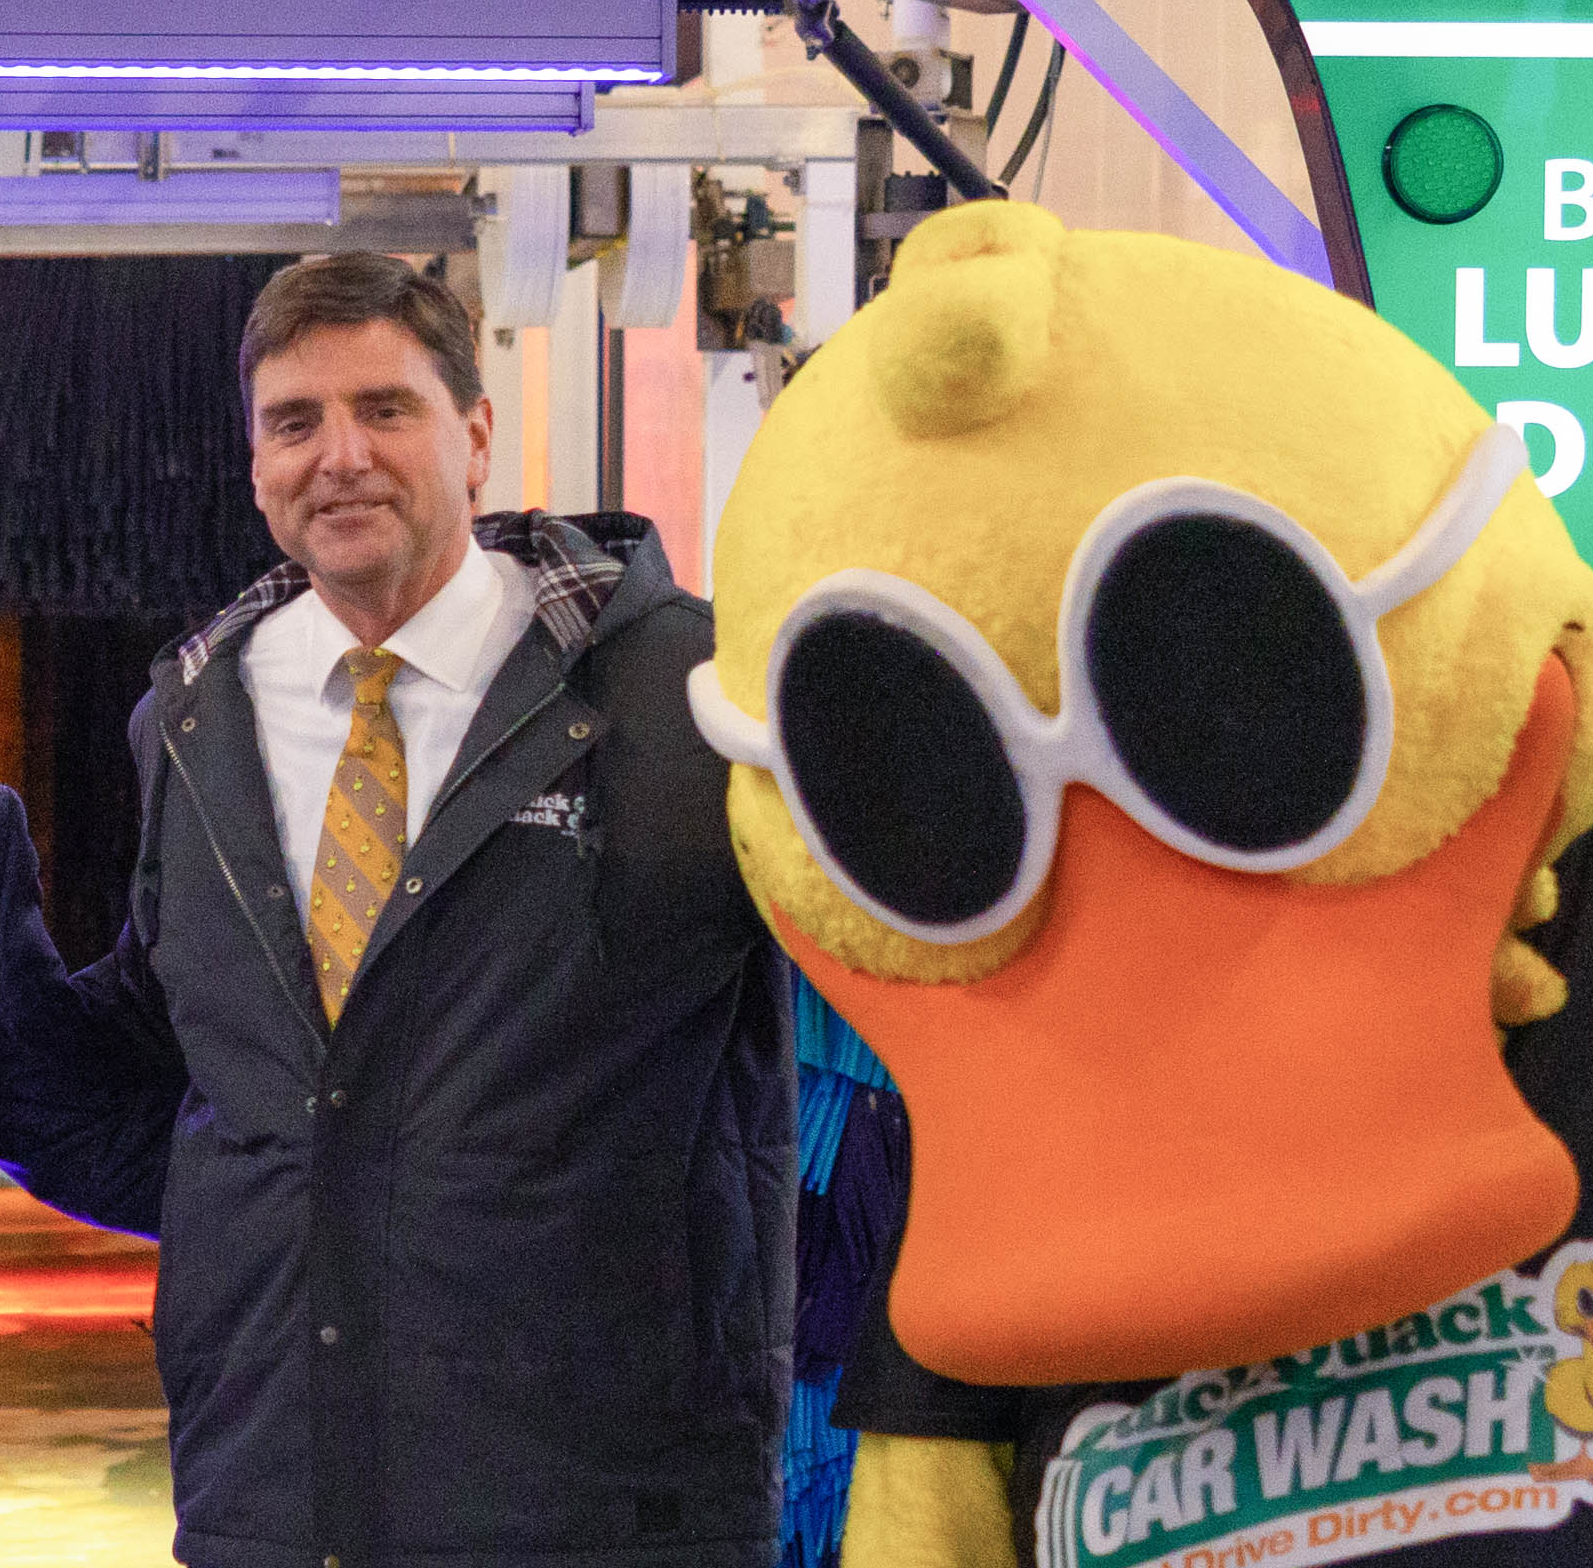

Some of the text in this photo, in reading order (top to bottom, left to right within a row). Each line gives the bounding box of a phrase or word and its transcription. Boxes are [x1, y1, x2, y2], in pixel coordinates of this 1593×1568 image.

[1081, 1364, 1537, 1557] CAR WASH
[1307, 1484, 1557, 1547] Dirty.com
